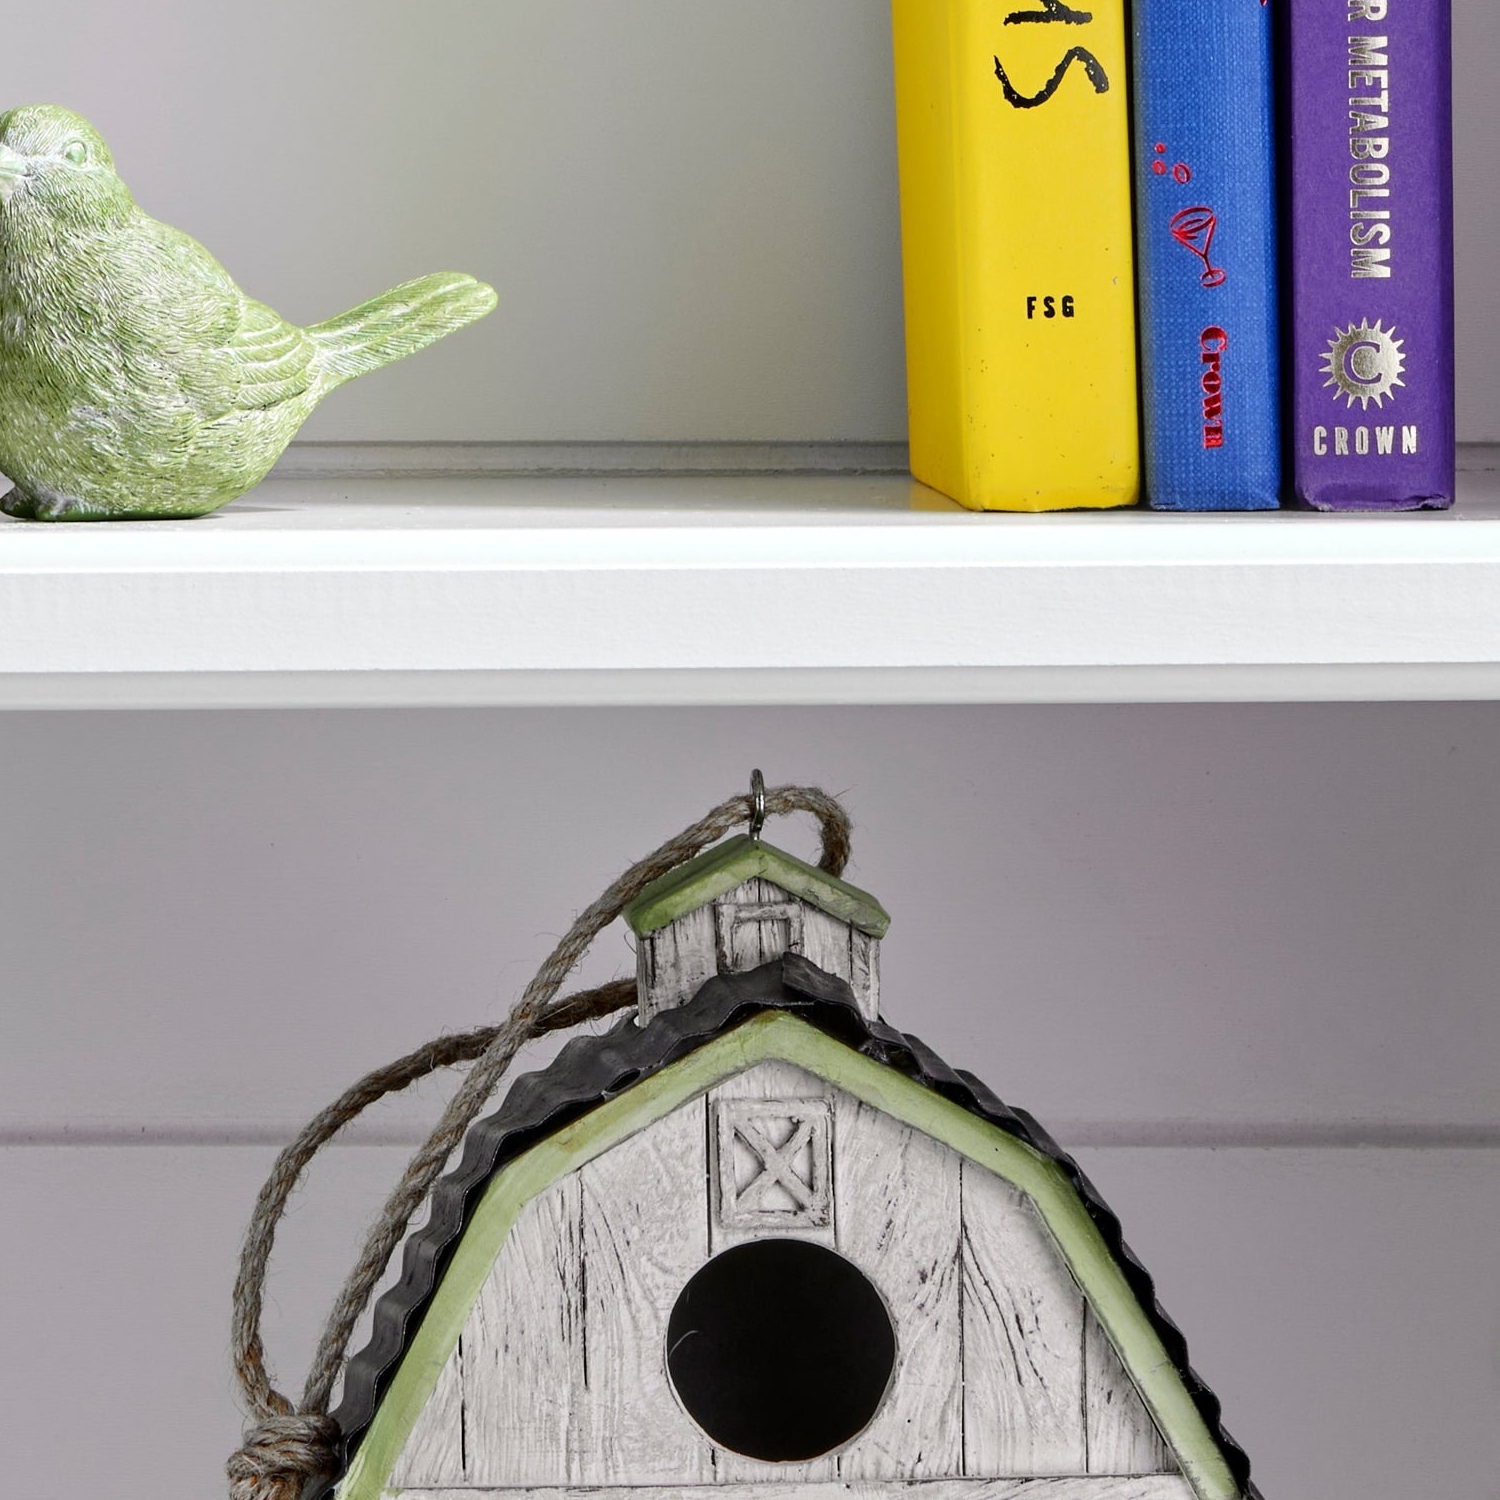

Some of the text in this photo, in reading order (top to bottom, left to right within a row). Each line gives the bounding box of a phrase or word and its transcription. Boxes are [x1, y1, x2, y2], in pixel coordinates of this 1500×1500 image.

[1347, 35, 1392, 280] METABOLISM
[1026, 295, 1075, 320] FSG
[1343, 340, 1383, 385] C
[1199, 324, 1228, 449] Crown
[1313, 425, 1417, 456] CROWN
